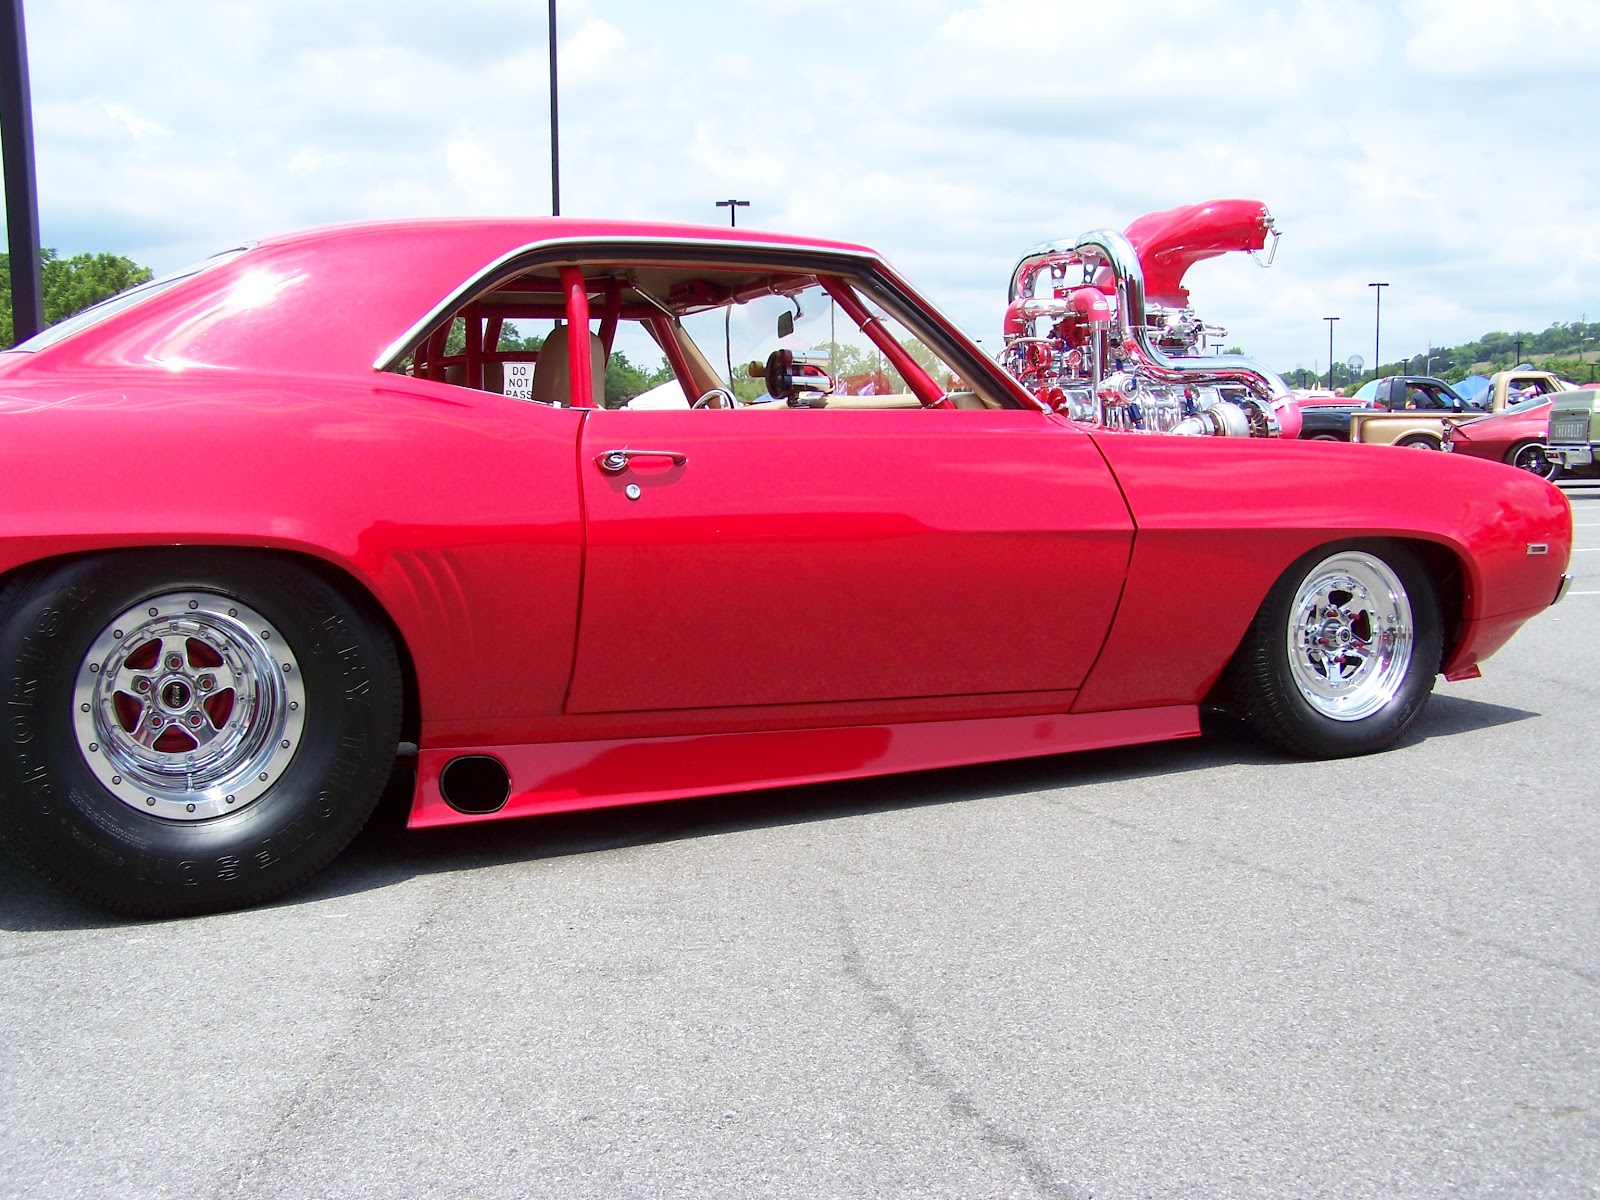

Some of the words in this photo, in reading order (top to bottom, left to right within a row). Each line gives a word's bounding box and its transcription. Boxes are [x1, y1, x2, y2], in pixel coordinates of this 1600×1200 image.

[512, 366, 526, 376] DO
[508, 378, 530, 388] NOT
[505, 390, 533, 400] PASS
[1555, 423, 1583, 438] CHEVROLET
